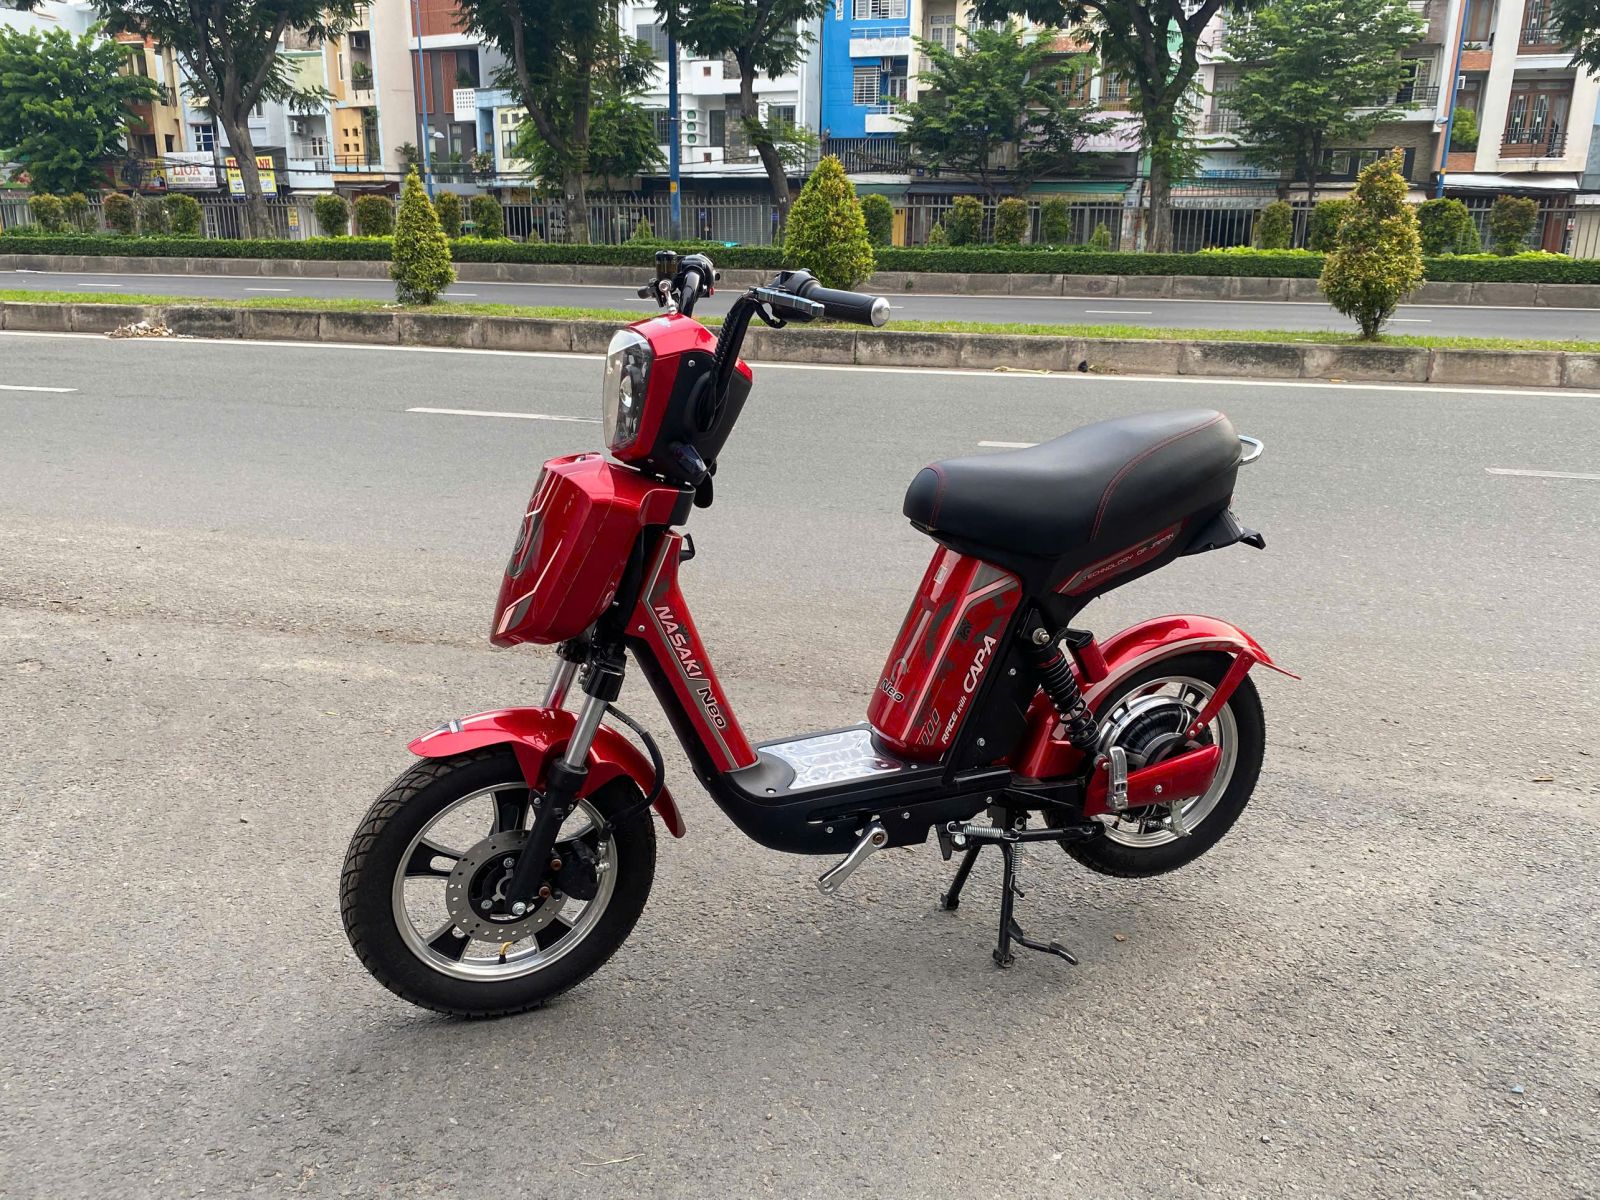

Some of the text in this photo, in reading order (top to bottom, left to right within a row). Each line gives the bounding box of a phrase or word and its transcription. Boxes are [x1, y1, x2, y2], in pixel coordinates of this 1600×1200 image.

[1082, 554, 1134, 581] TECHNOLOGY
[1136, 546, 1148, 556] OF
[655, 606, 726, 728] NASAKI Neo
[880, 678, 904, 702] Neo
[941, 711, 958, 744] RACE
[963, 635, 997, 693] CAPA
